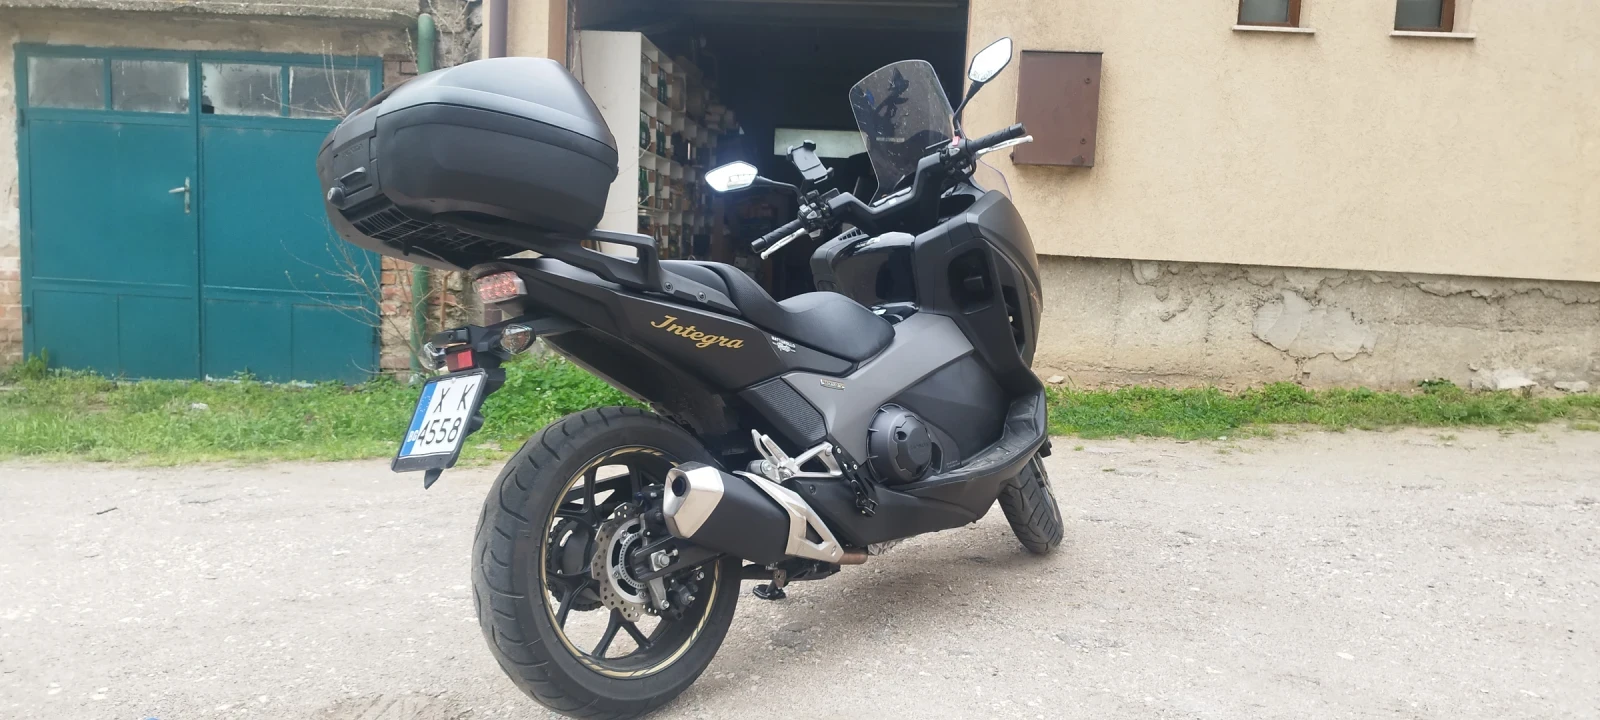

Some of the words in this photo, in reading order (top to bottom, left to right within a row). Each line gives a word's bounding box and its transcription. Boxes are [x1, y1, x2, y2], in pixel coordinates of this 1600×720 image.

[650, 314, 745, 350] Integra
[433, 387, 451, 413] X
[457, 383, 475, 410] K
[418, 417, 462, 447] 4558
